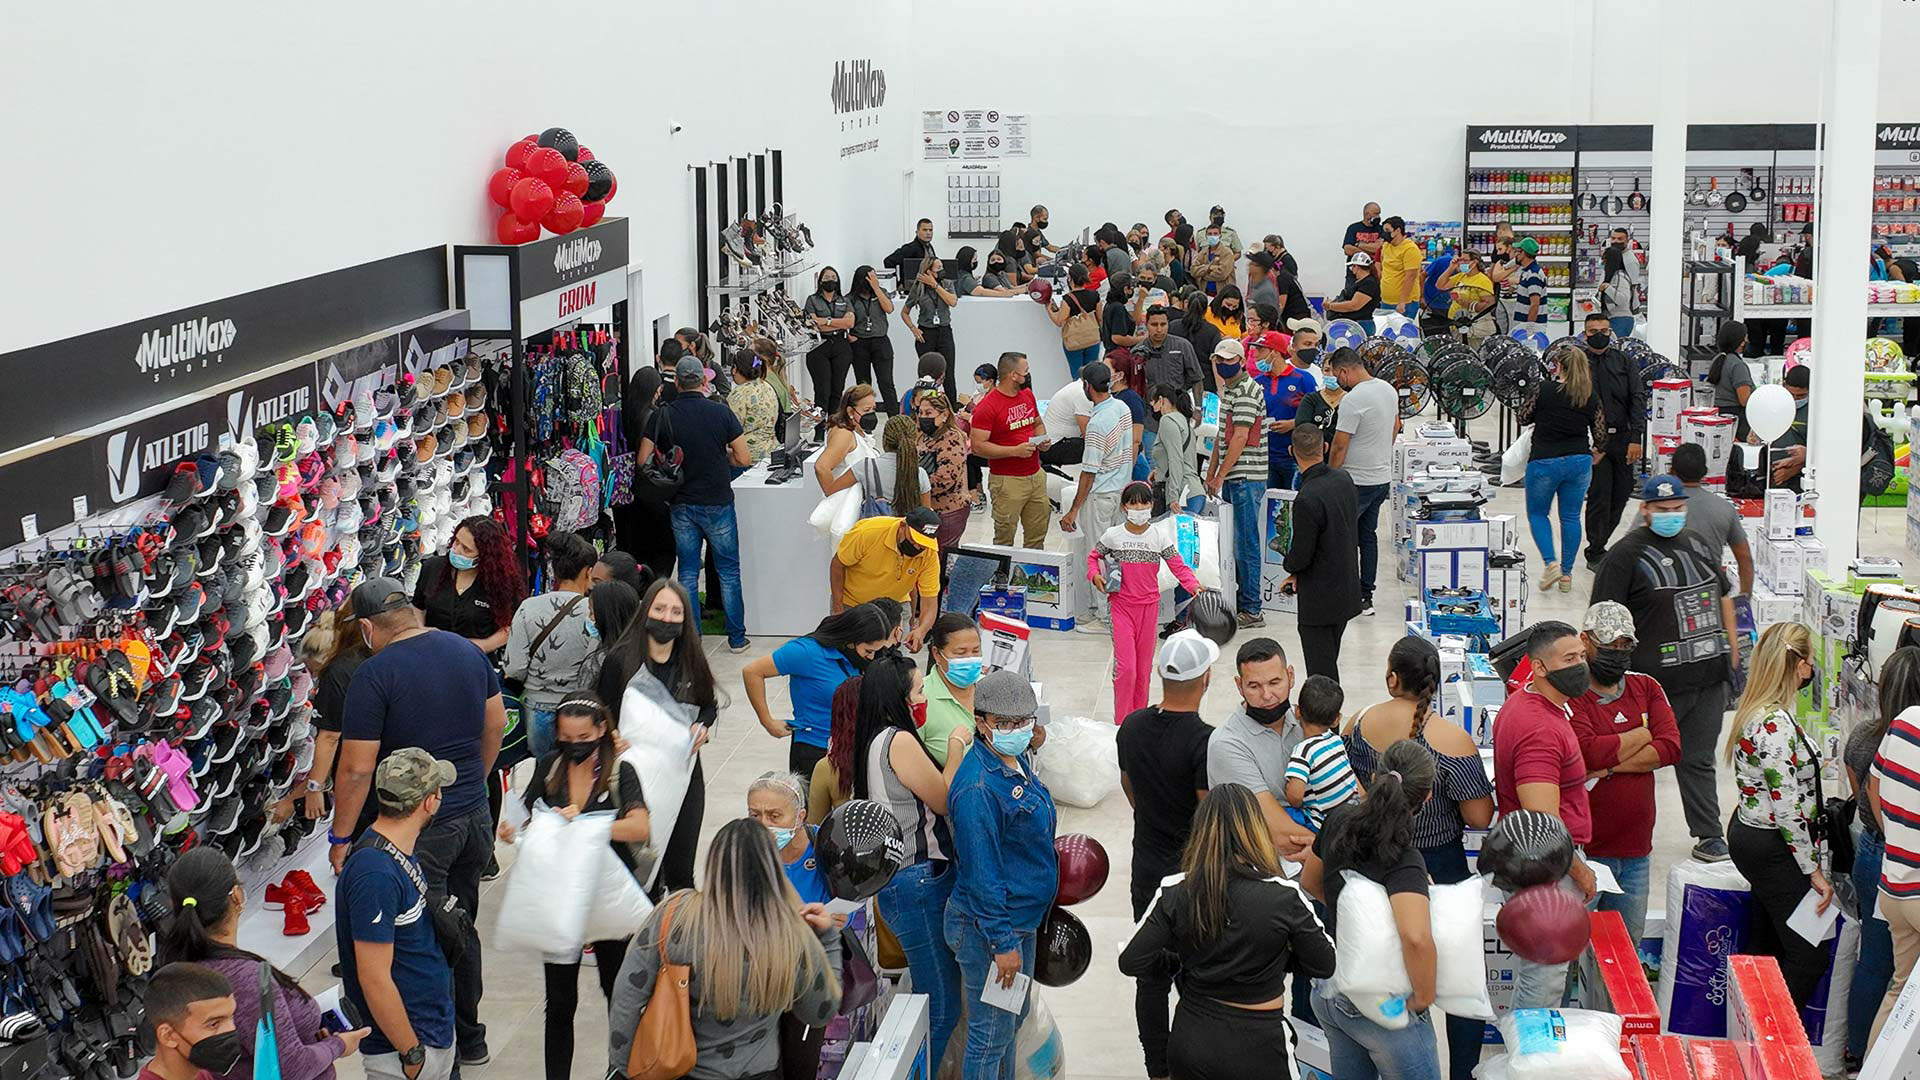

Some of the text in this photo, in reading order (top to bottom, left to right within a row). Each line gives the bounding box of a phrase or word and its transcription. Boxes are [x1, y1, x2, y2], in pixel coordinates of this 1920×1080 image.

[832, 59, 886, 114] MultiMax
[1481, 129, 1566, 144] MultiMax
[555, 237, 601, 273] MultiMax
[559, 281, 596, 319] CROM
[137, 316, 236, 372] MultiMax
[153, 353, 223, 383] STORE
[255, 385, 310, 429] ATLETIC
[142, 422, 209, 472] ATLETIC
[1122, 542, 1150, 550] STAY REAL
[1263, 574, 1279, 602] CLX
